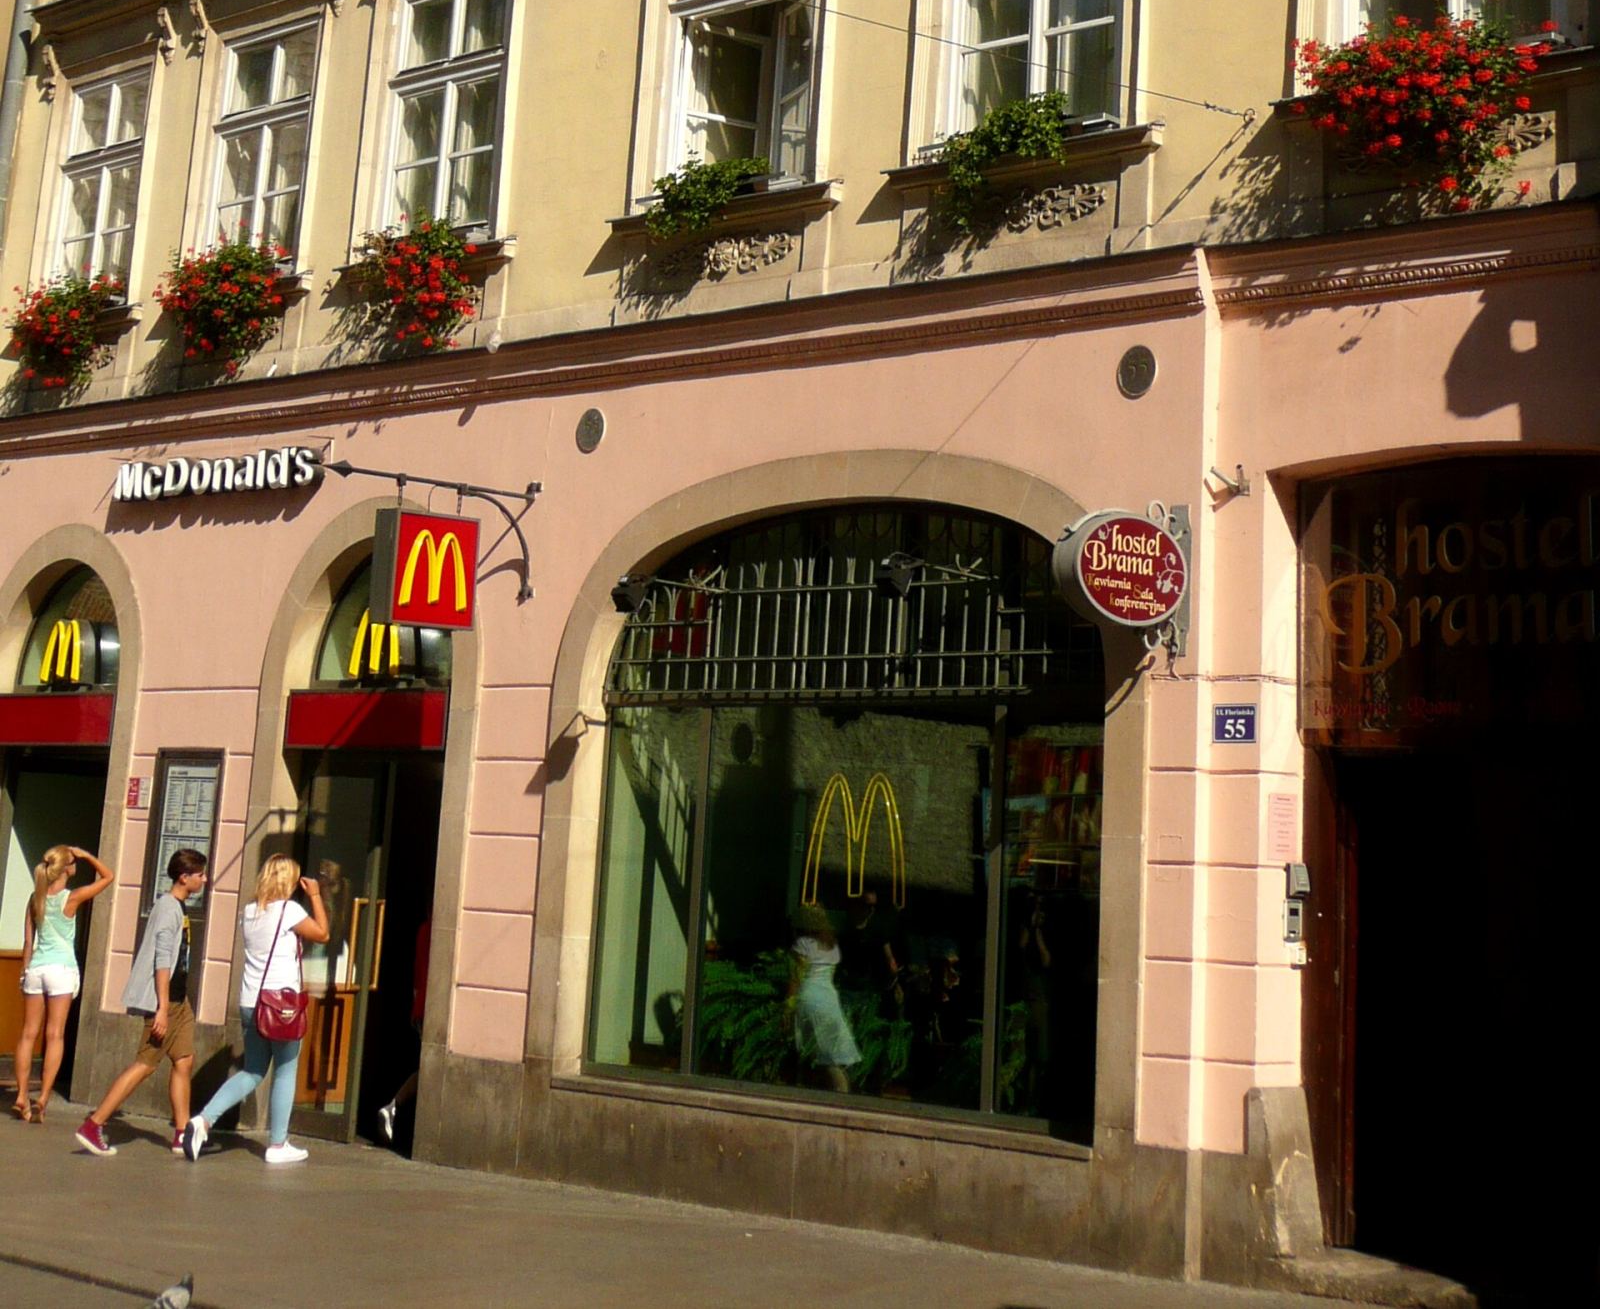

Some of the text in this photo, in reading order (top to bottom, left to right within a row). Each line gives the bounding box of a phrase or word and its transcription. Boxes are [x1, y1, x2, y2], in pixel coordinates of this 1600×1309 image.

[113, 446, 318, 502] McDonald's
[1084, 540, 1154, 576] Brama
[1112, 525, 1163, 557] hostel
[398, 529, 467, 612] M
[1085, 572, 1132, 591] Kawiarnia
[1320, 573, 1599, 675] Brama
[1224, 718, 1246, 738] 55
